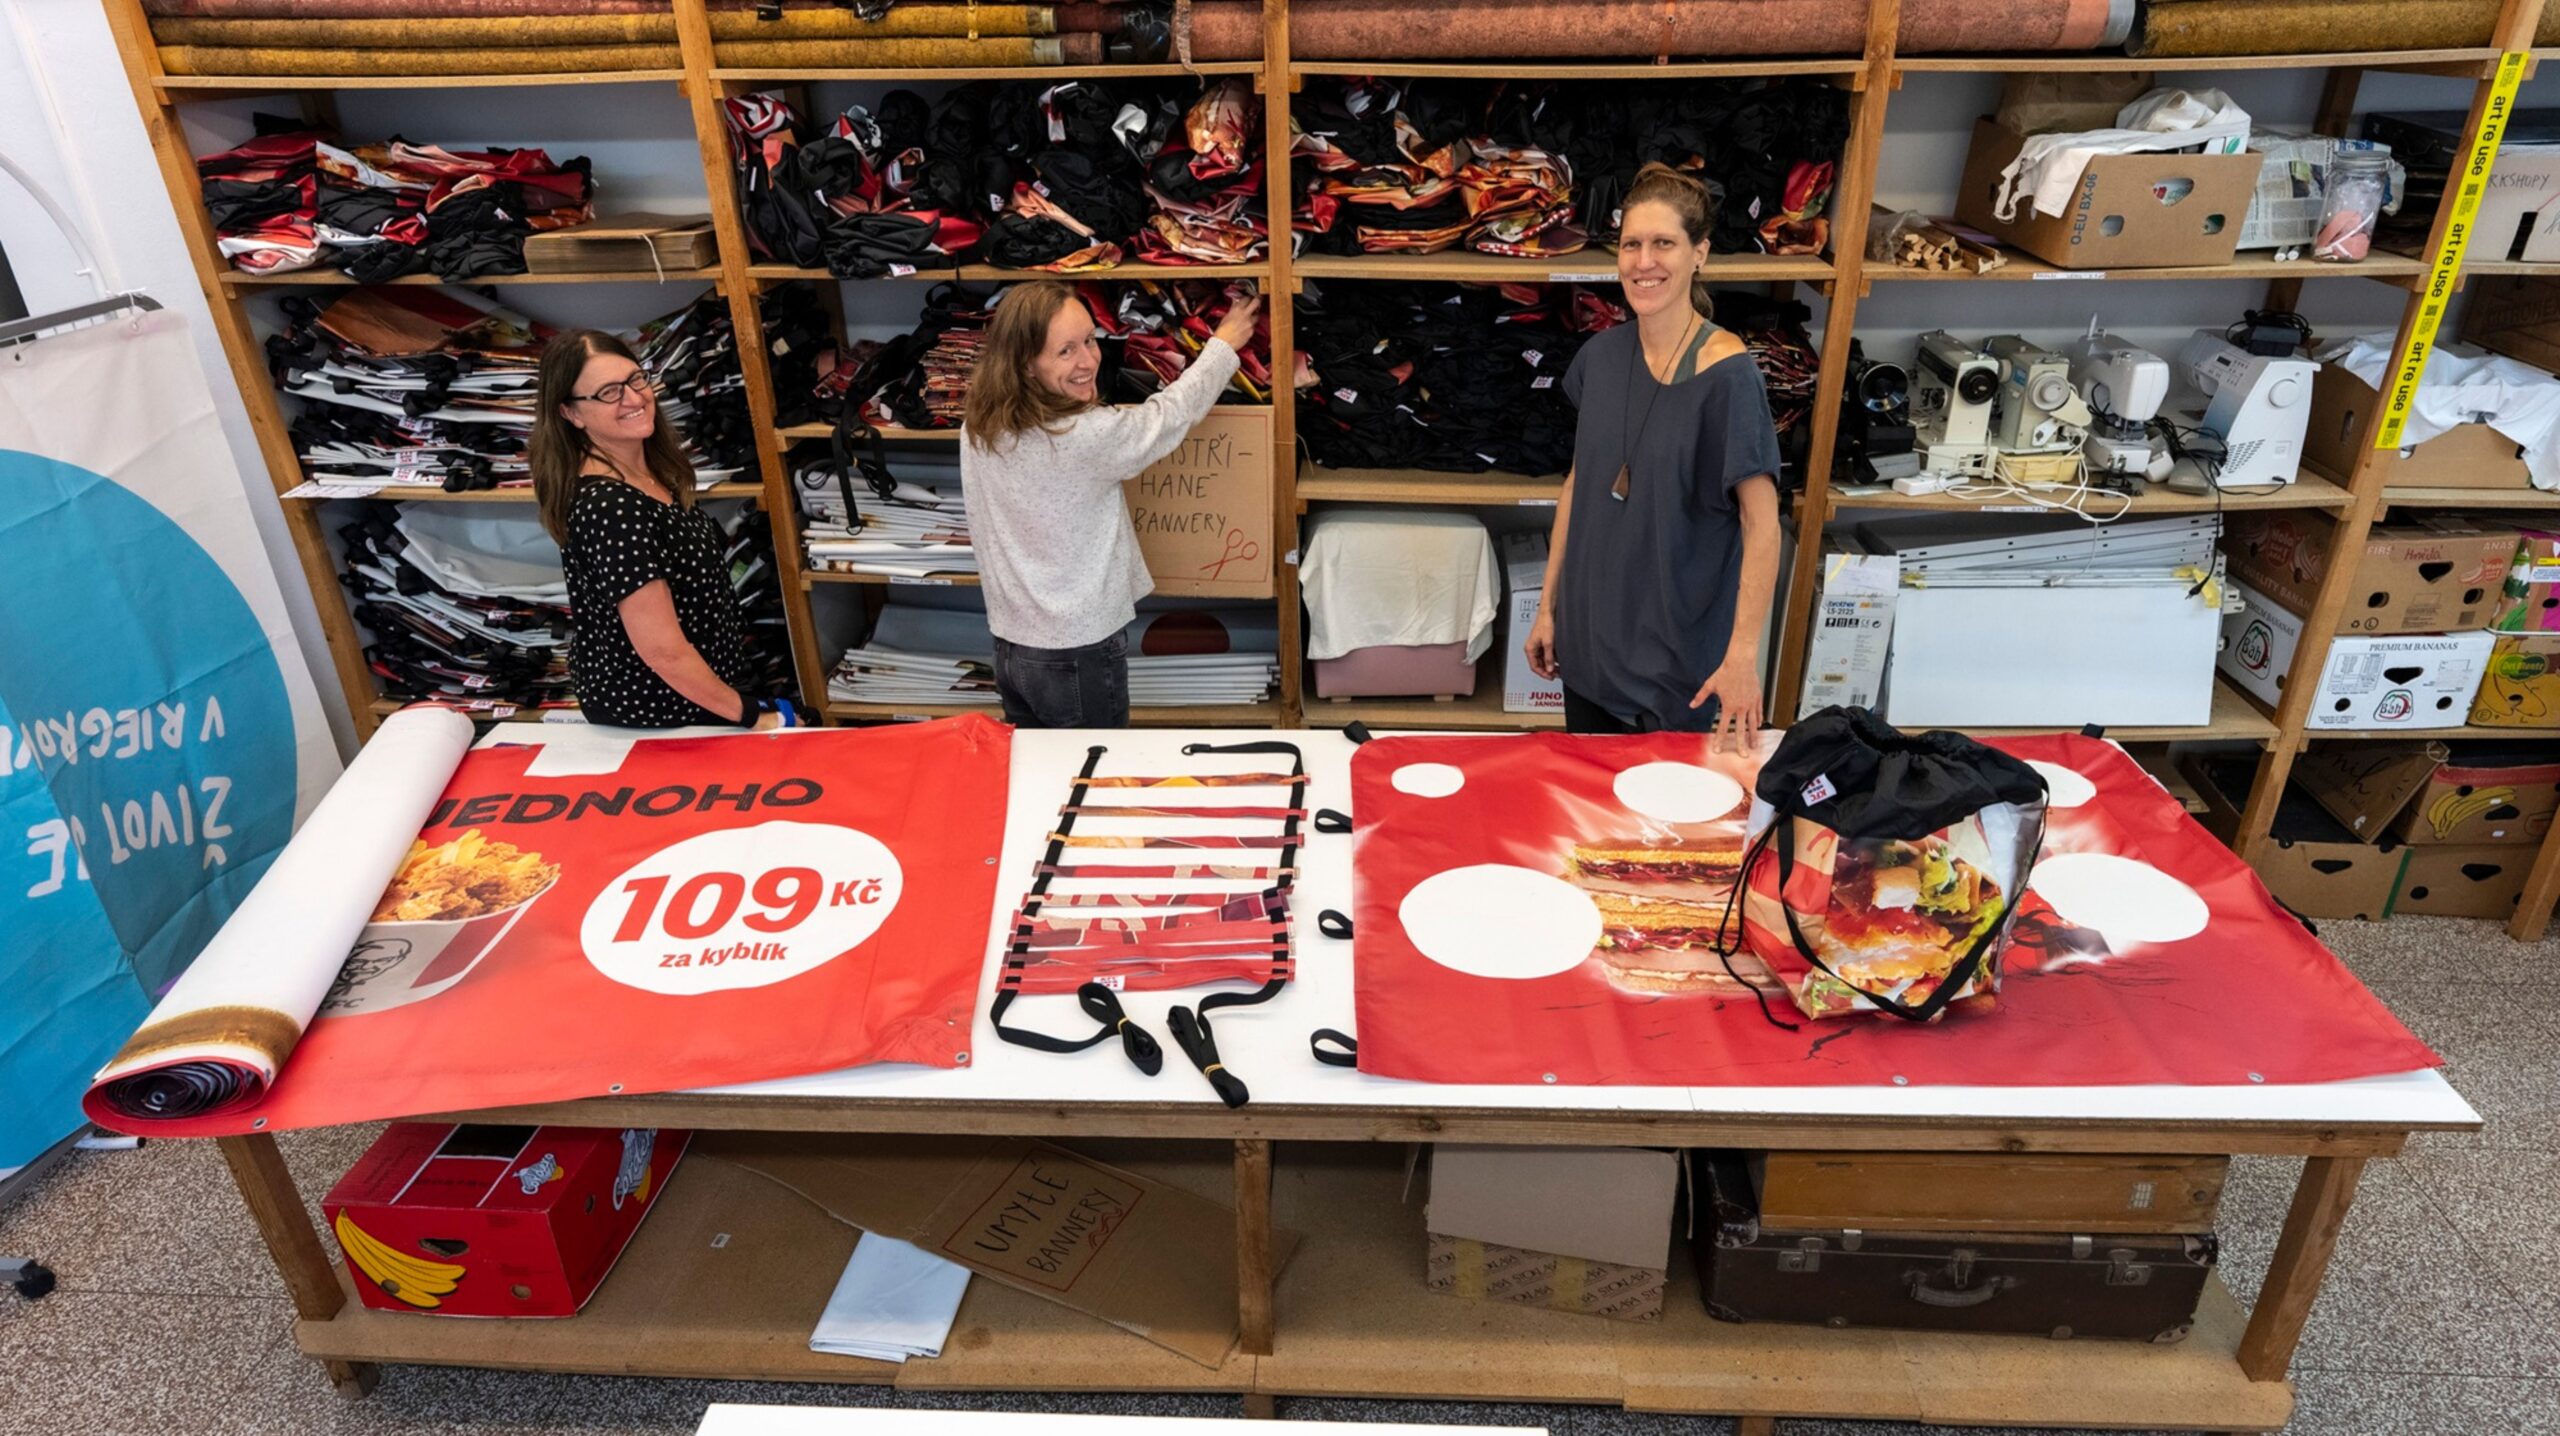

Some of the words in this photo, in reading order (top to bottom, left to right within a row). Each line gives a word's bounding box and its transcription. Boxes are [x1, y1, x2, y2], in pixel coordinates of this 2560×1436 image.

[2489, 95, 2507, 121] art
[2483, 124, 2498, 141] re
[2471, 145, 2492, 176] use
[2488, 173, 2550, 191] RKSHOPY
[2448, 222, 2465, 246] art
[2442, 249, 2457, 266] re
[2431, 269, 2450, 298] use
[2408, 341, 2425, 364] art
[2402, 366, 2418, 382] re
[2392, 384, 2411, 412] use
[1133, 507, 1227, 538] BANNERY
[2367, 545, 2392, 555] FIRS
[2483, 541, 2515, 551] ANAS
[1827, 607, 1855, 615] LS-2125
[2369, 643, 2412, 652] PREMIUM
[2414, 642, 2459, 651] BANANAS
[1529, 691, 1563, 700] JUNO
[199, 695, 226, 742] V
[424, 778, 825, 829] JEDNOHO
[611, 866, 825, 944] 109
[829, 877, 884, 908] Kč
[658, 949, 691, 969] za
[698, 941, 790, 968] kyblík
[1025, 1188, 1122, 1273] BANNERY
